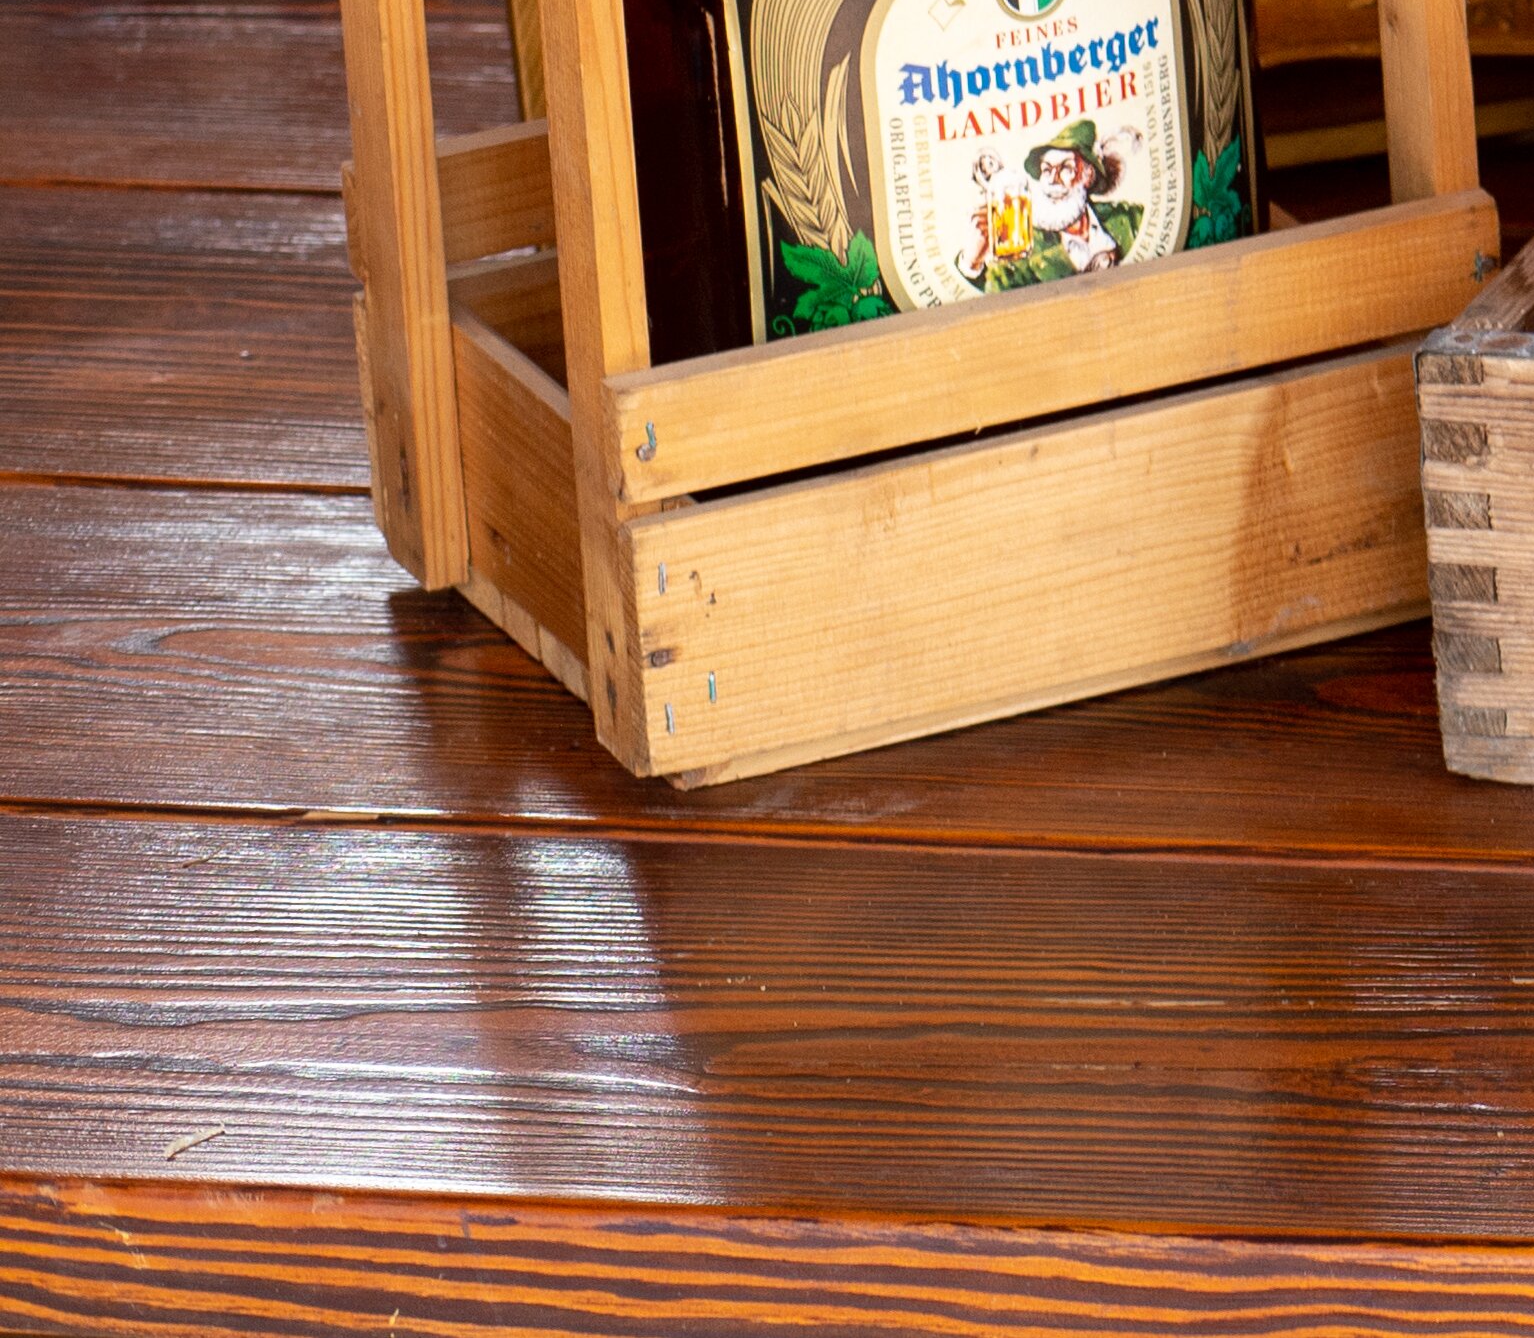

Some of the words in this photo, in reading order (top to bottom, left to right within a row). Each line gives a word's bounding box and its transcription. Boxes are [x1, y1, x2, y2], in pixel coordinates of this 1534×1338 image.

[897, 16, 1160, 109] Ahornberger
[995, 16, 1079, 49] FEINES
[937, 70, 1139, 142] LANDBIER
[1143, 60, 1155, 98] 1516
[1133, 146, 1163, 263] HEITSGEBOT
